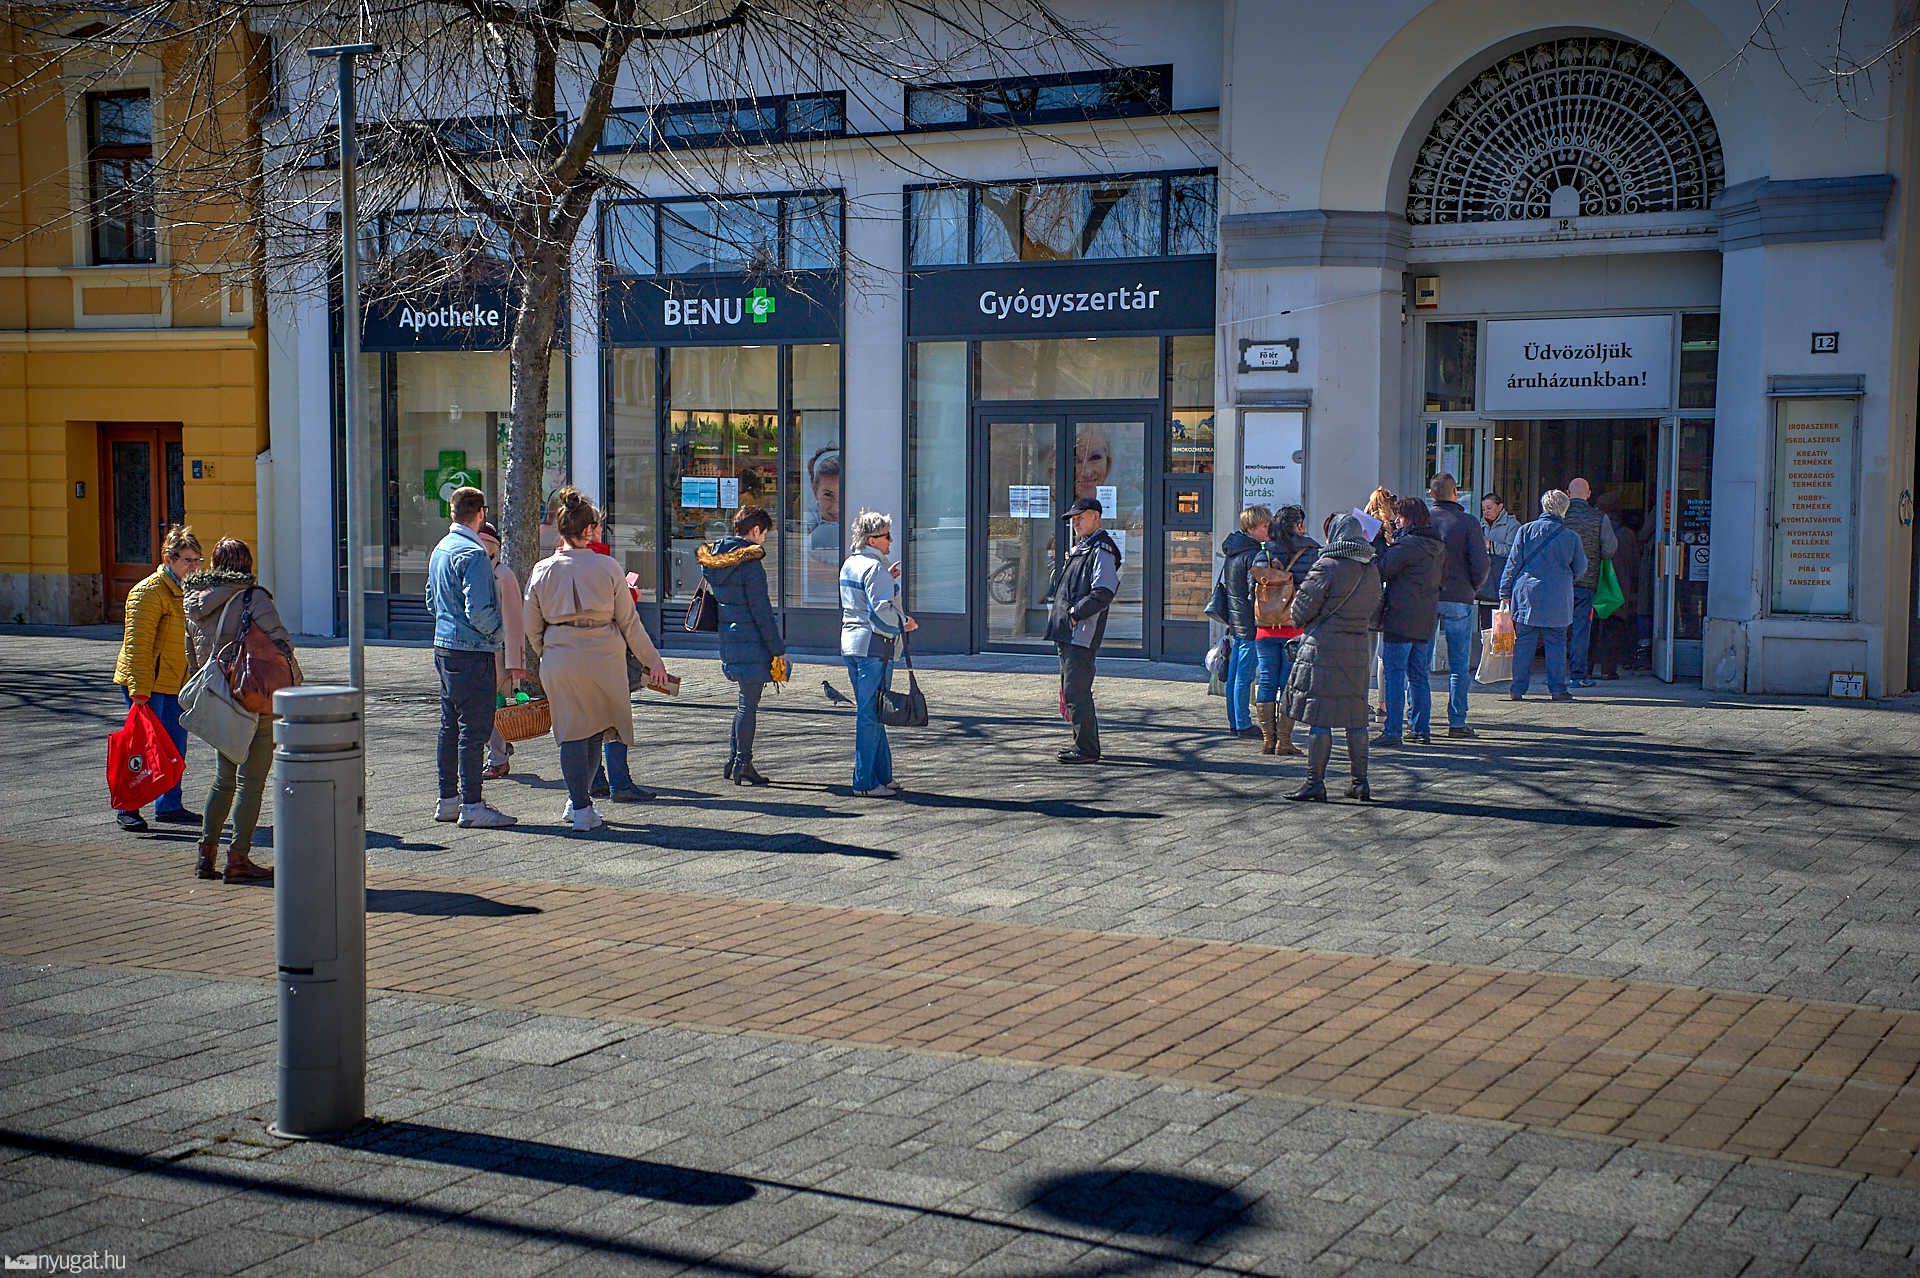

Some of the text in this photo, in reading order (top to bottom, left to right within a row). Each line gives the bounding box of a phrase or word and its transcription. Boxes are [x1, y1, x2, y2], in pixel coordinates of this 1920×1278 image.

[664, 297, 742, 326] BENU
[979, 283, 1160, 320] Gyógyszertár
[399, 303, 500, 333] Apotheke
[1523, 341, 1633, 364] Üdvözöljük
[1817, 337, 1834, 349] 12
[1506, 370, 1648, 389] áruházunkban!
[1244, 475, 1275, 487] Nyitva
[1244, 487, 1275, 498] tartás:
